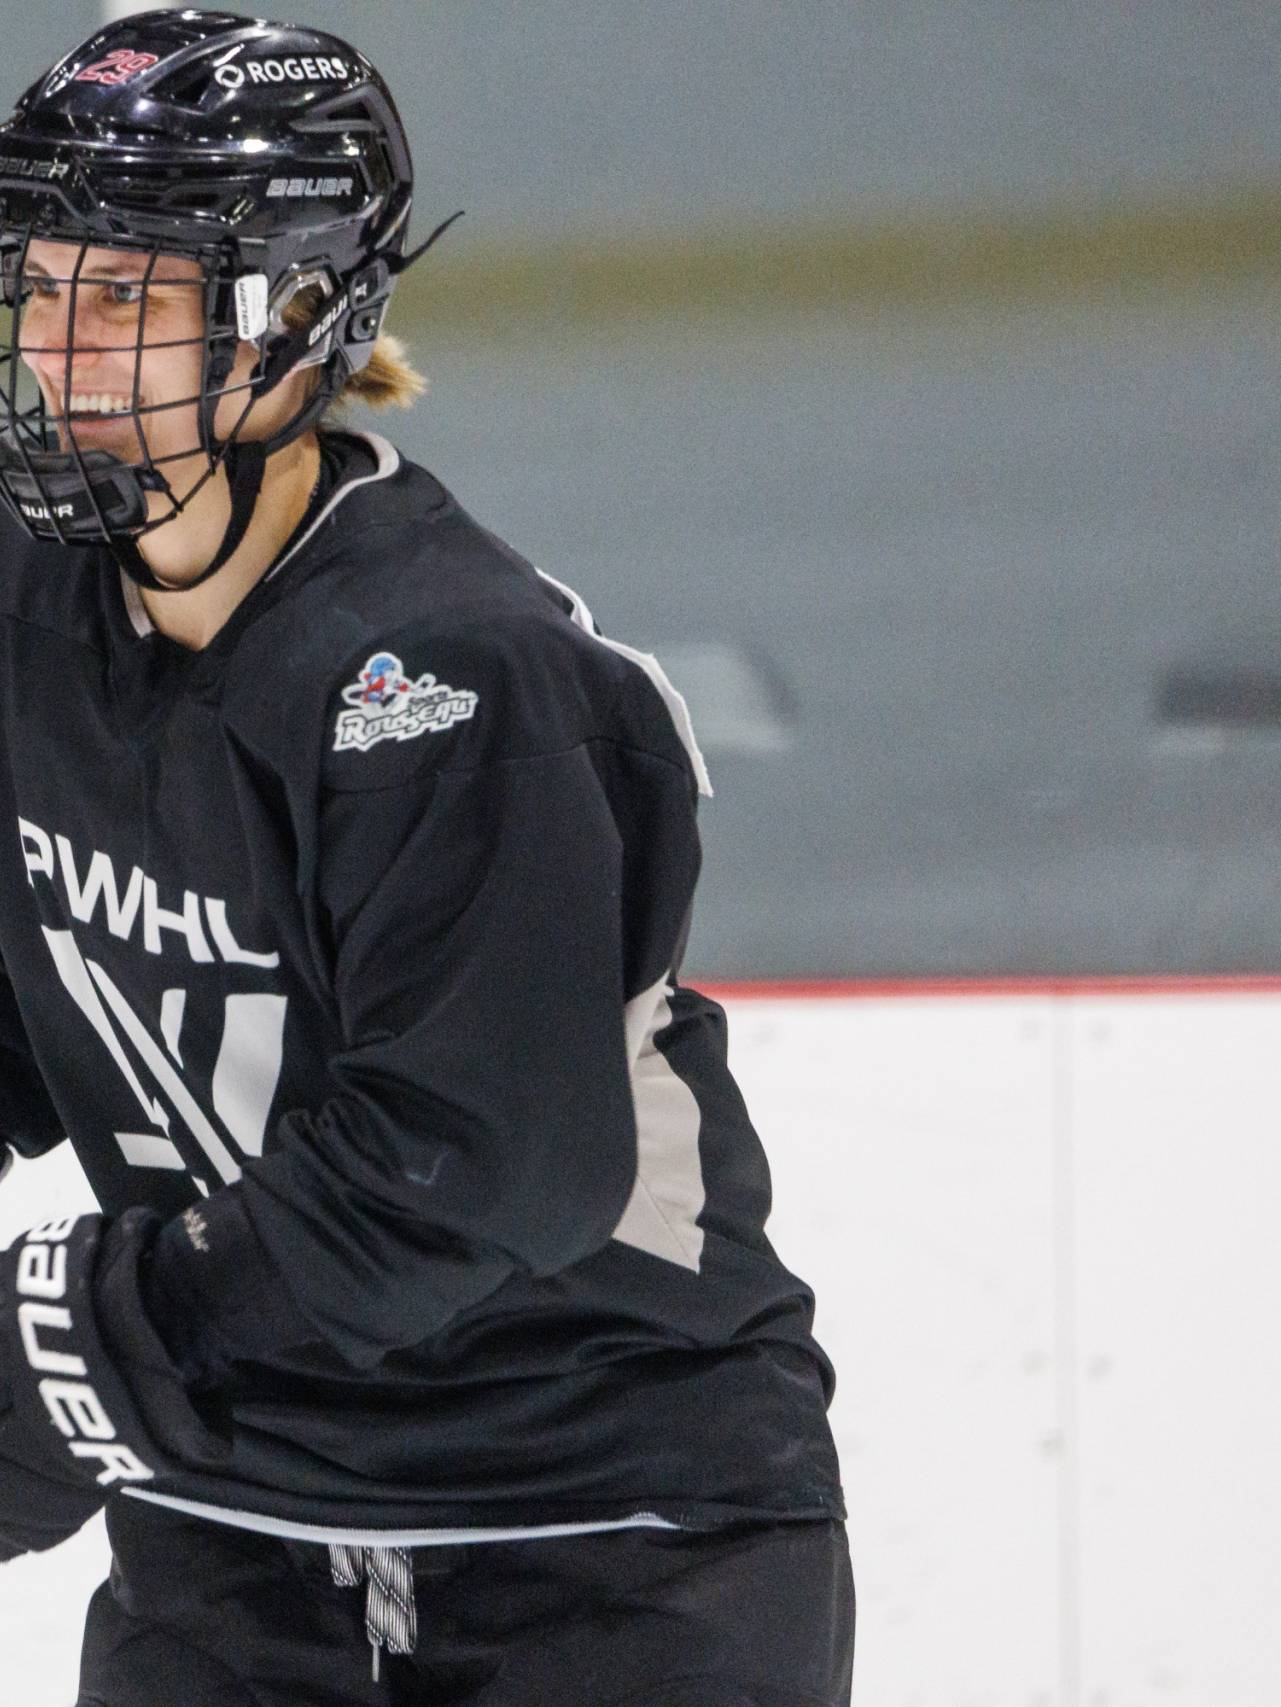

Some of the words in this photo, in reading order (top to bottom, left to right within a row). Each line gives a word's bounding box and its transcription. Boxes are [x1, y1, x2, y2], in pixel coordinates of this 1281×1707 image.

[75, 49, 159, 85] 29
[245, 57, 349, 84] ROGERS
[266, 176, 353, 197] BAUER
[238, 282, 250, 336] BAUER
[308, 294, 348, 347] BAU
[17, 815, 280, 969] PWHL
[15, 1217, 155, 1486] BAUER
